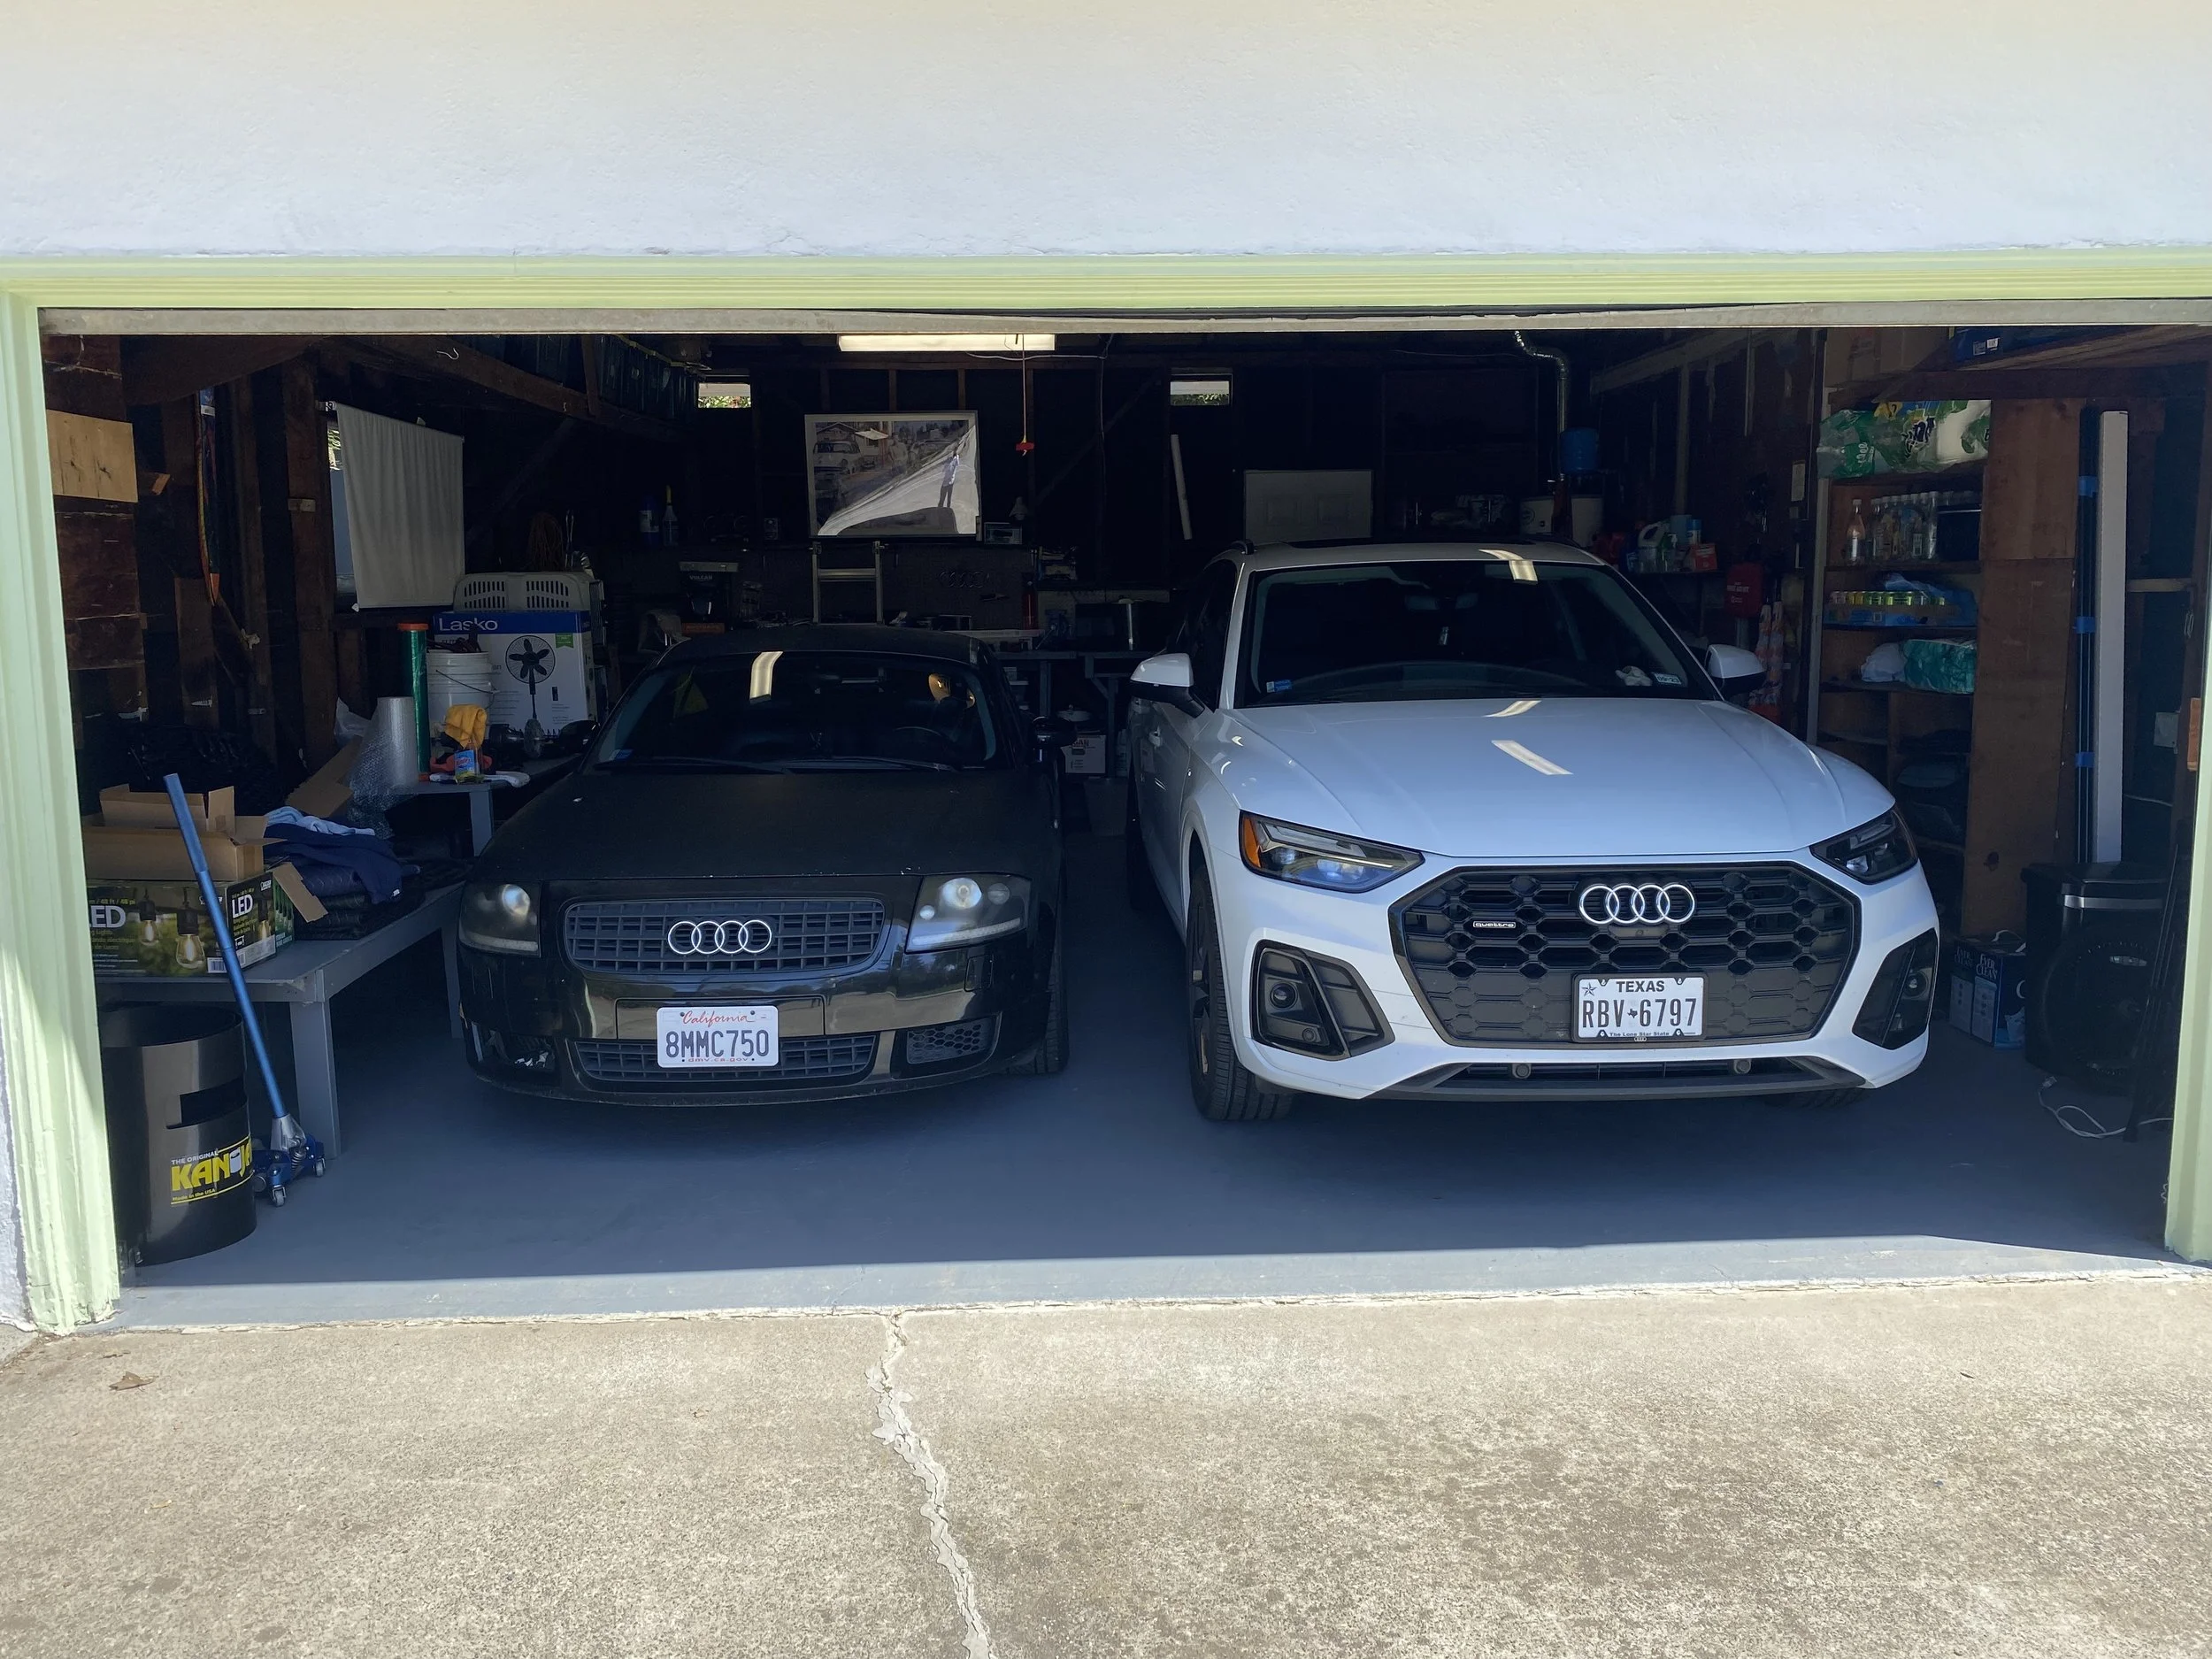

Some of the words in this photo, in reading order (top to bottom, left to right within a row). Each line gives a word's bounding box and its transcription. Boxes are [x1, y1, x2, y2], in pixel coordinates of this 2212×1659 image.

[439, 617, 498, 632] Lasko
[89, 904, 127, 928] ED
[232, 894, 254, 918] LED
[1617, 980, 1665, 993] TEXAS
[682, 1010, 755, 1027] California
[1582, 1000, 1624, 1028] RBV
[1640, 998, 1697, 1027] 6797
[665, 1029, 769, 1058] 8MMC750
[187, 1149, 219, 1163] ORIGINAL
[171, 1152, 231, 1192] KAN
